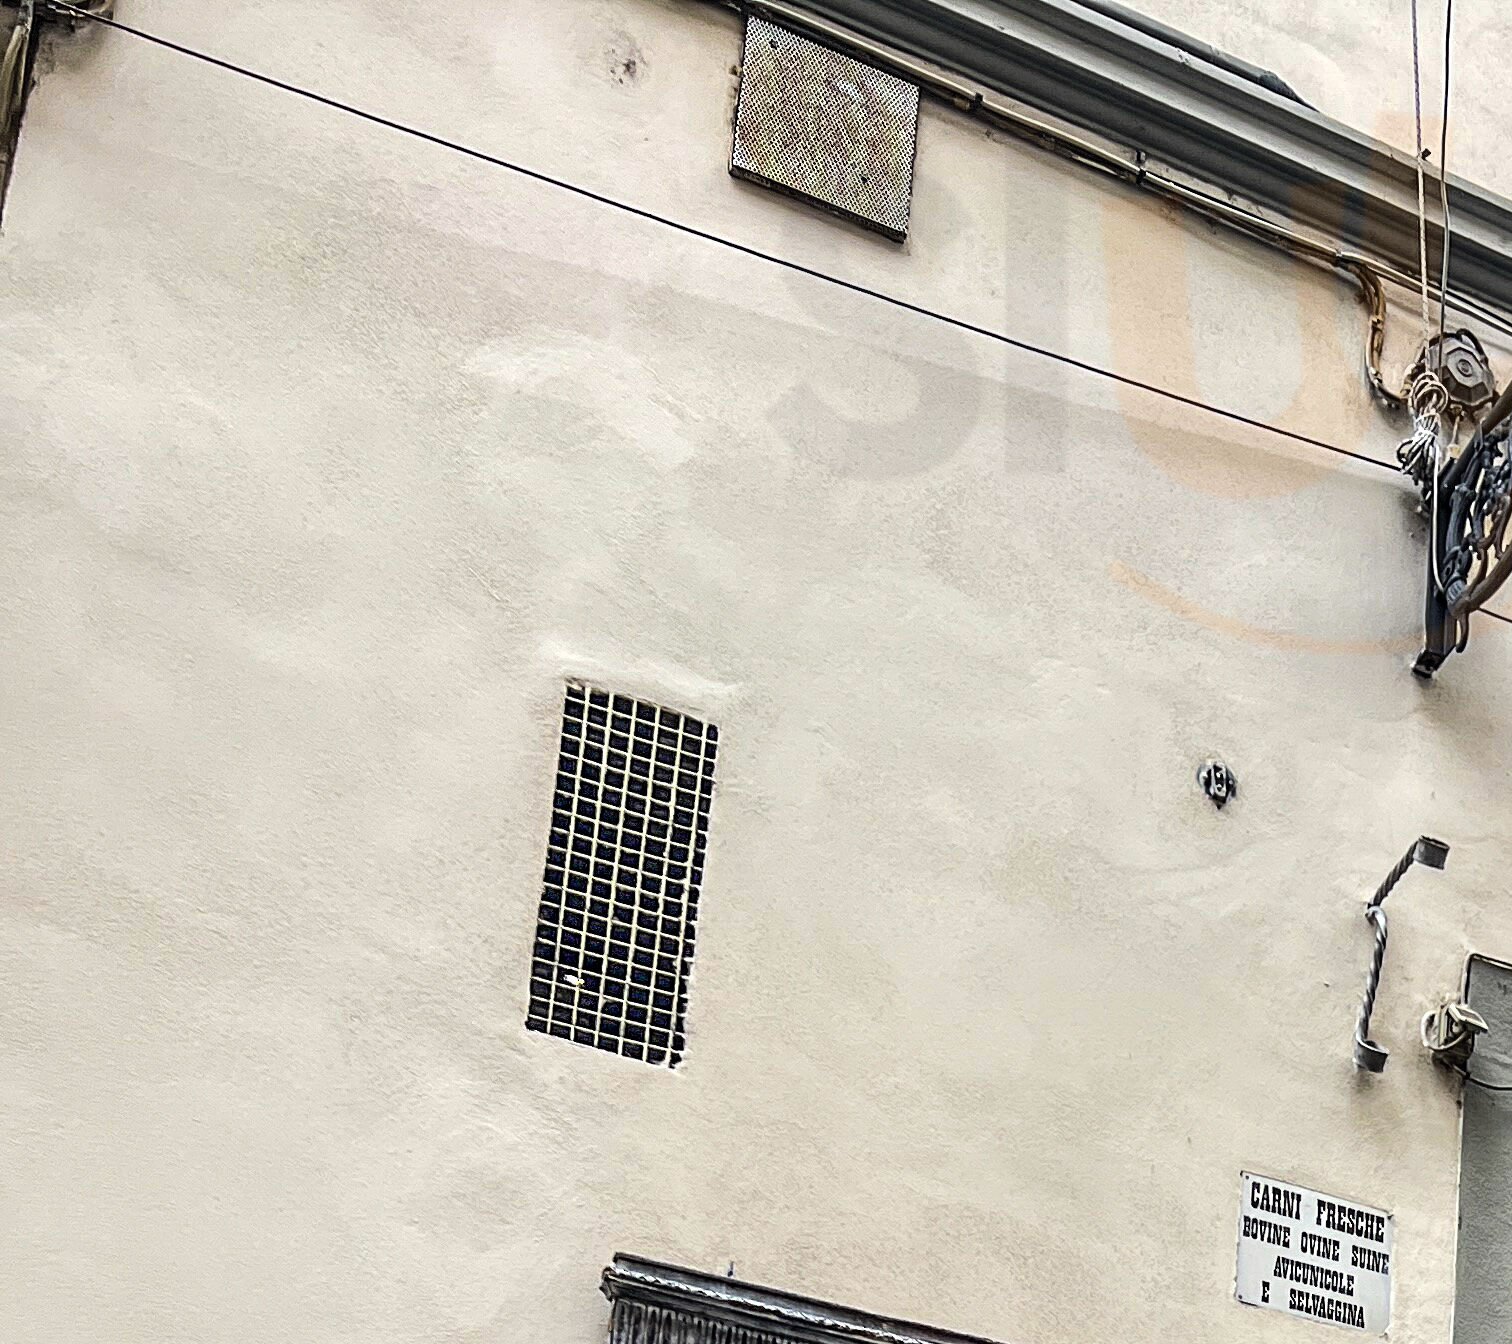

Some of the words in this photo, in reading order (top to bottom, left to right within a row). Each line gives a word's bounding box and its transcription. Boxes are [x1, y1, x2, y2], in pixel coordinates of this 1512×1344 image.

[1250, 1181, 1302, 1220] CARNI
[1316, 1198, 1385, 1243] FRESCHE
[1243, 1215, 1291, 1248] BOVINE
[1300, 1231, 1340, 1261] OVINE
[1351, 1245, 1389, 1275] SUINE
[1273, 1255, 1355, 1296] AVICUNICOLE
[1261, 1280, 1271, 1303] E
[1289, 1288, 1365, 1329] SELVAGGINA
